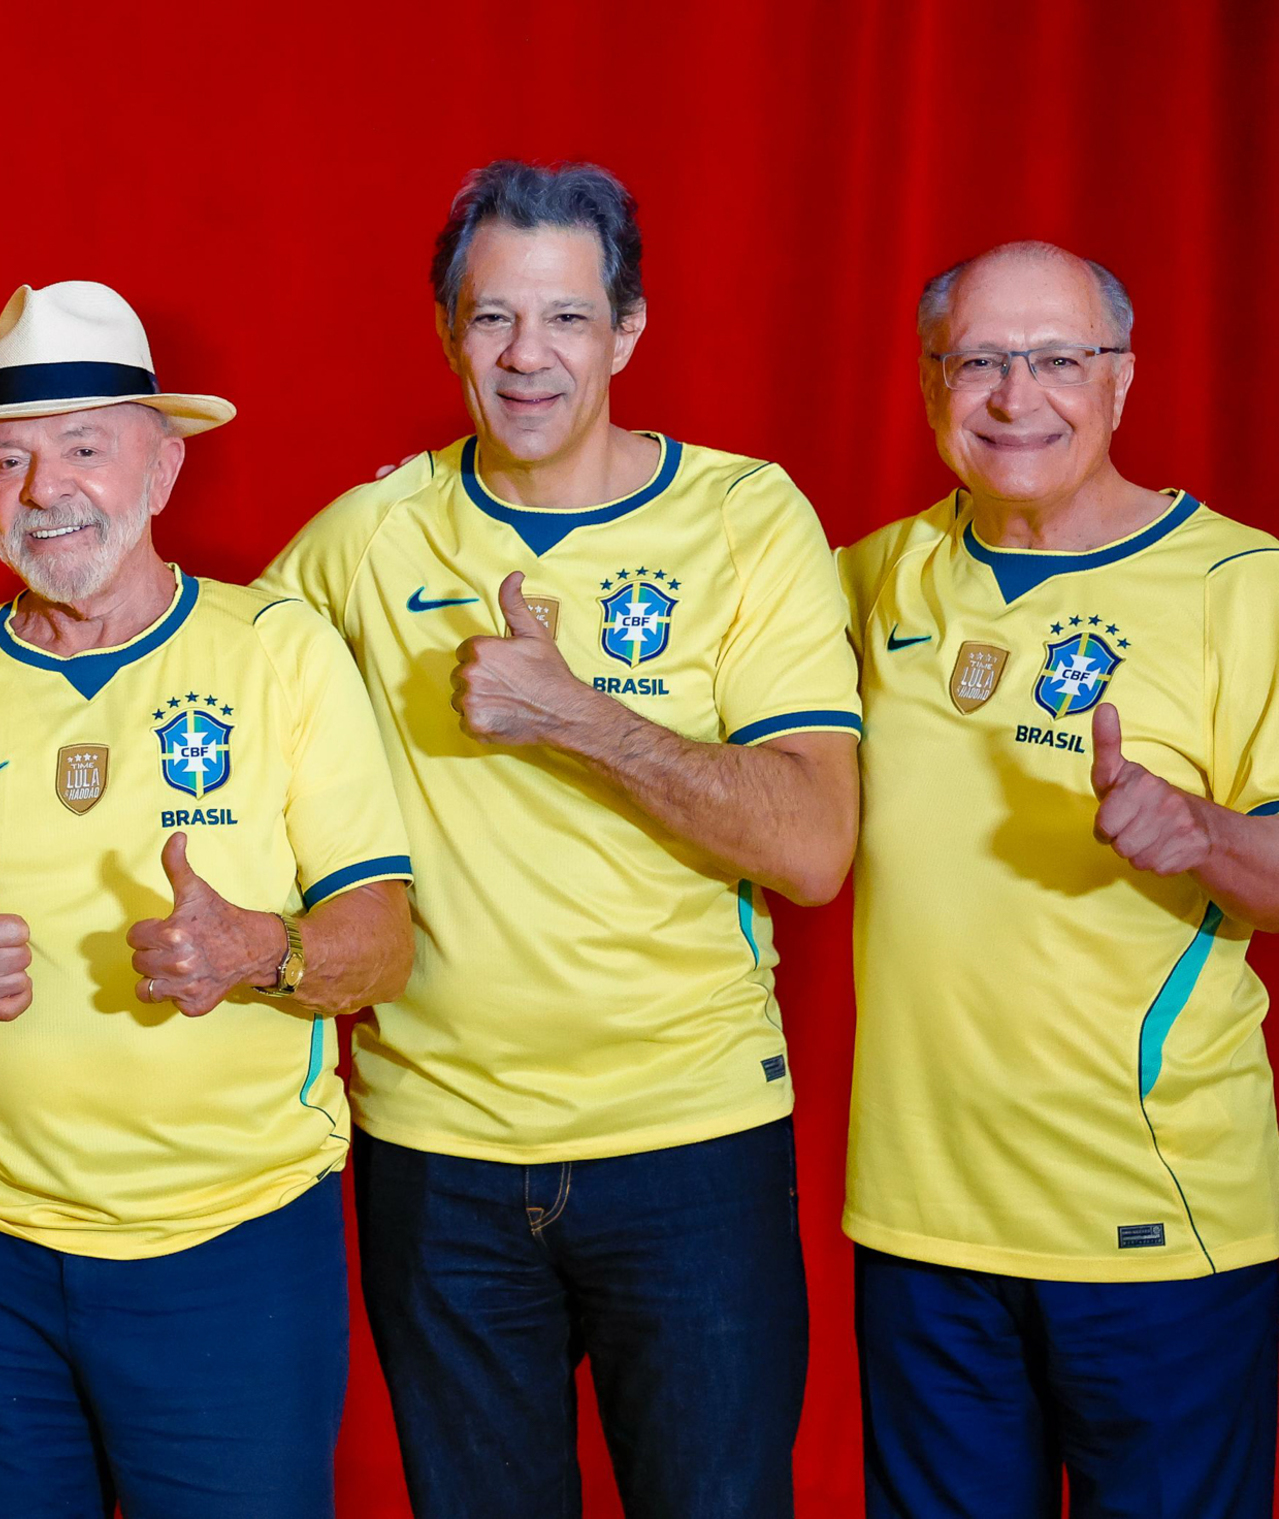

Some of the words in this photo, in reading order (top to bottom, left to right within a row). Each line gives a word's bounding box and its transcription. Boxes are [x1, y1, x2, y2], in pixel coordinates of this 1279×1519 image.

[622, 616, 651, 627] CBF
[961, 667, 994, 689] LULA
[1062, 669, 1091, 681] CBF
[593, 677, 670, 696] BRASIL
[1015, 724, 1086, 754] BRASIL
[181, 746, 209, 757] CBF
[66, 768, 99, 789] LULA
[161, 808, 238, 828] BRASIL
